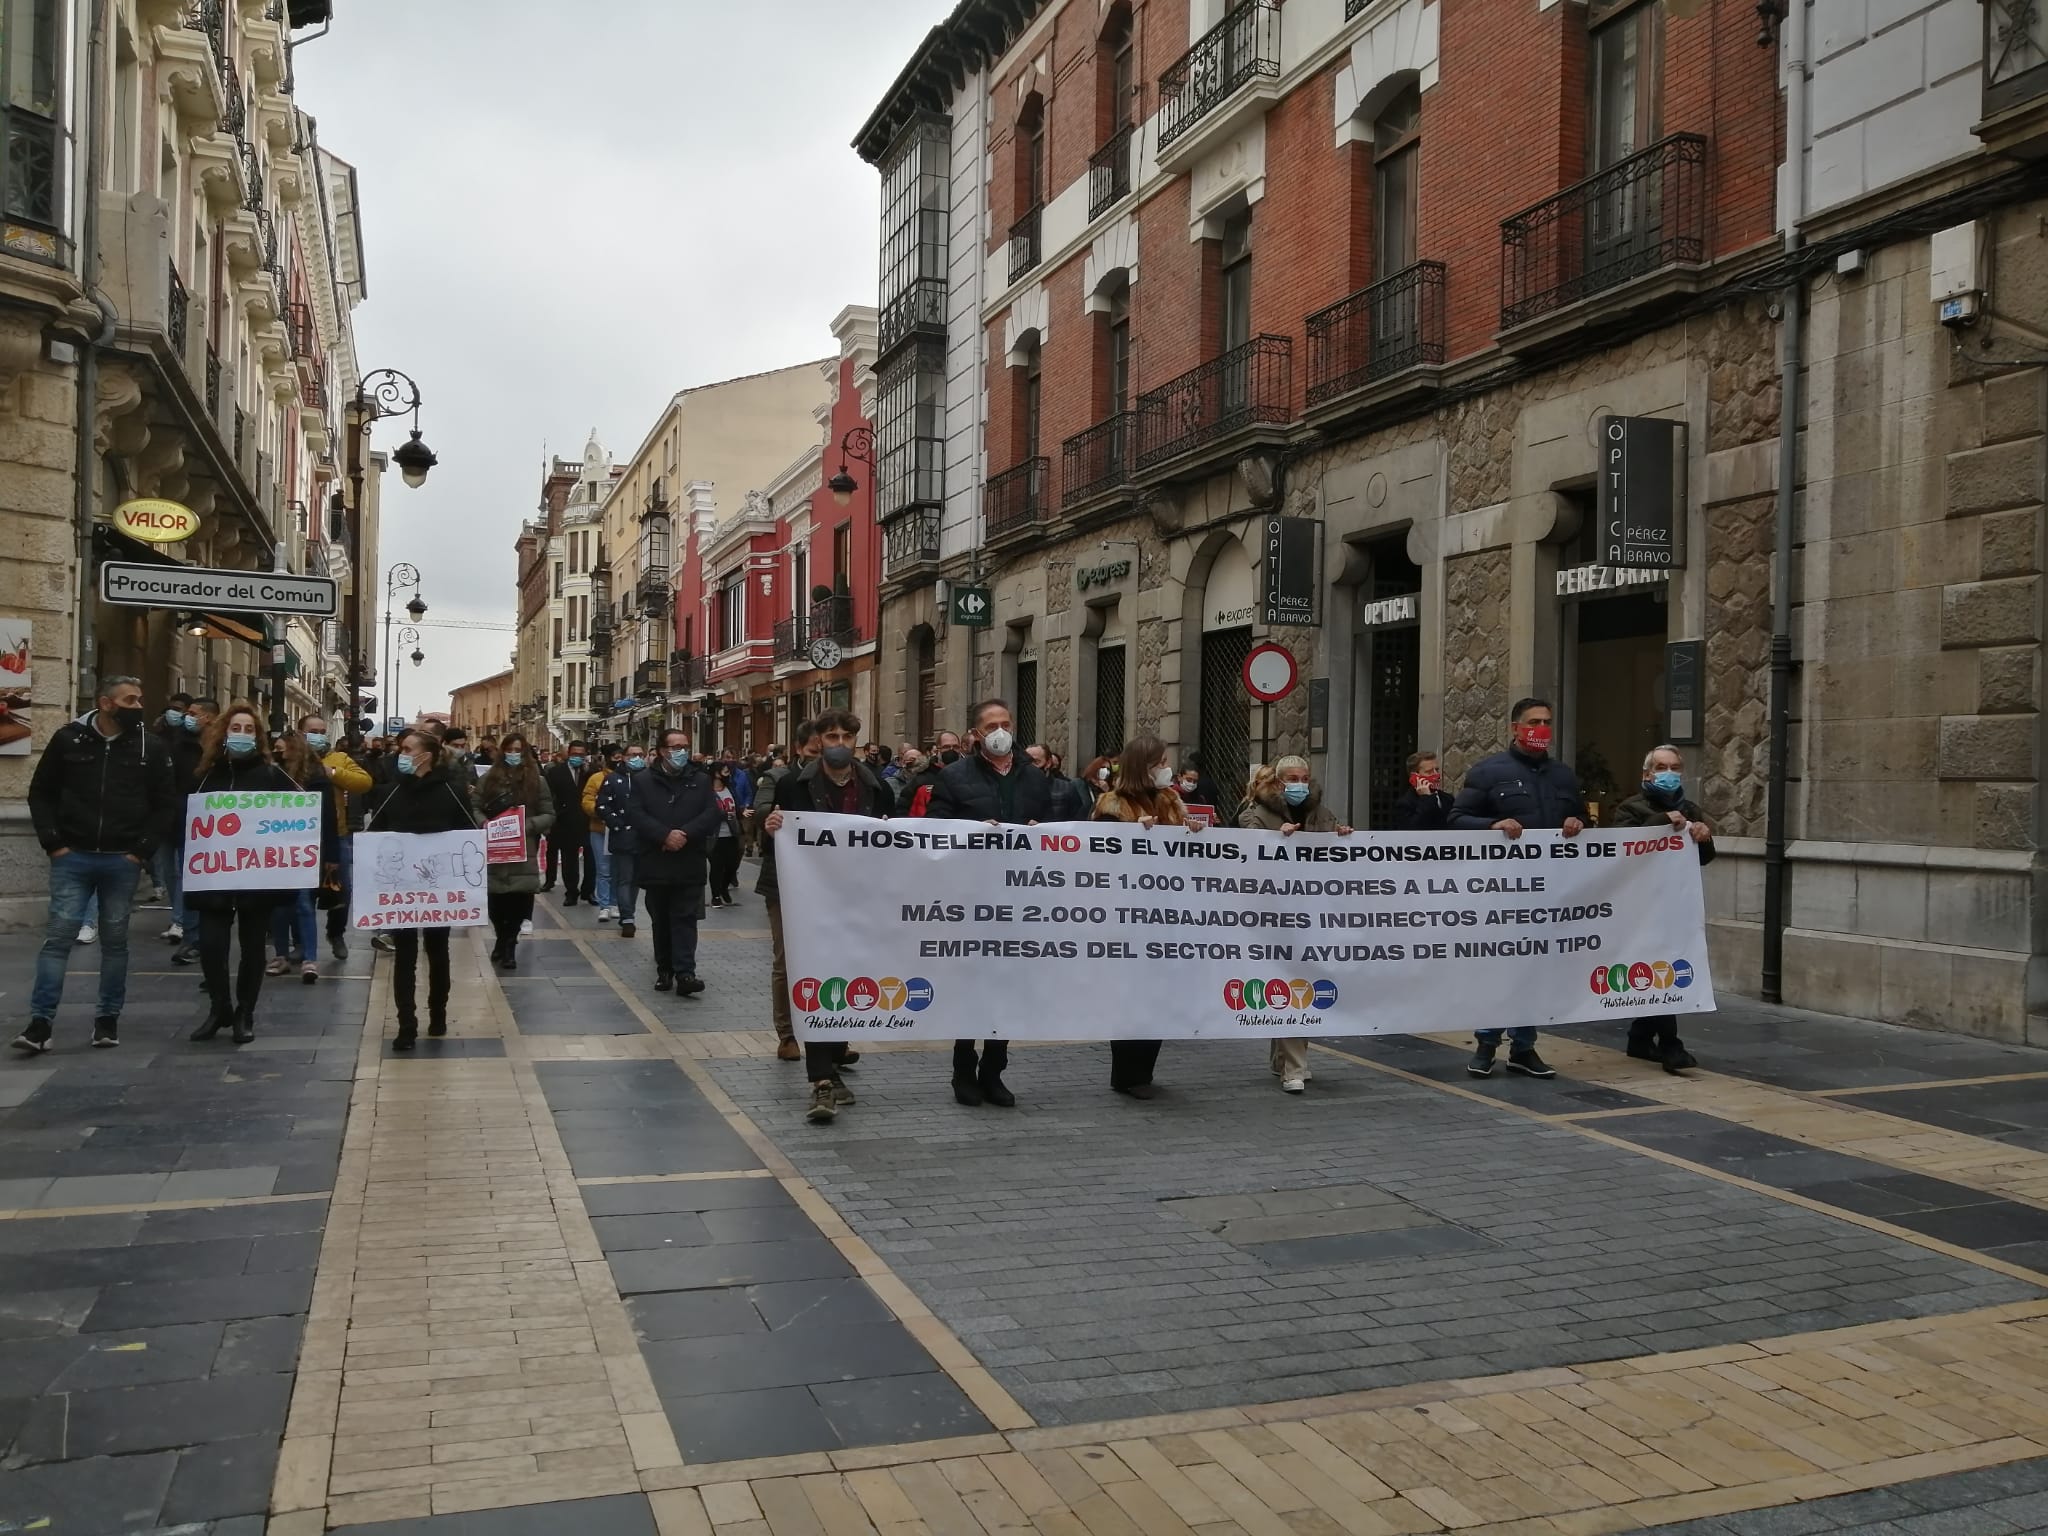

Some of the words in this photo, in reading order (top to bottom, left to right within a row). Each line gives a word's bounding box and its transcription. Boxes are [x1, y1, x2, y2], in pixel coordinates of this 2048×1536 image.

[1608, 420, 1624, 561] ÓPTICA
[123, 510, 188, 530] VALOR
[1627, 525, 1667, 541] PÉREZ
[1627, 550, 1671, 563] BRAVO
[1090, 560, 1131, 586] express
[1556, 564, 1615, 595] PEREZ
[117, 575, 221, 597] Procurador
[227, 584, 255, 599] del
[261, 585, 324, 603] Común
[1280, 595, 1309, 607] PÉREZ
[1280, 613, 1311, 623] BRAVO
[1365, 597, 1415, 625] OPTICA
[205, 793, 320, 810] NOSOTROS
[191, 813, 241, 840] NO
[256, 817, 318, 835] SOMOS
[797, 829, 836, 847] LA
[848, 829, 1032, 850] HOSTELERÍA
[1040, 835, 1081, 852] NO
[1089, 837, 1122, 854] ES
[1131, 838, 1158, 856] EL
[1163, 840, 1247, 863] VIRUS,
[1258, 845, 1289, 861] LA
[1295, 845, 1542, 862] RESPONSABILIDAD
[1550, 842, 1579, 859] ES
[1587, 842, 1617, 858] DE
[1622, 835, 1684, 857] TODOS
[189, 845, 319, 874] CULPABLES
[1005, 866, 1066, 887] MÁS
[1075, 872, 1110, 888] DE
[1118, 873, 1184, 891] 1.000
[1191, 876, 1396, 896] TRABAJADORES
[1403, 880, 1420, 894] A
[1428, 879, 1459, 894] LA
[1466, 877, 1545, 893] CALLE
[378, 892, 439, 905] BASTA
[447, 891, 466, 903] DE
[901, 901, 965, 922] MÁS
[974, 905, 1013, 922] DE
[1022, 906, 1106, 923] 2.000
[1115, 907, 1311, 929] TRABAJADORES
[1320, 910, 1477, 928] INDIRECTOS
[1485, 902, 1613, 925] AFECTADOS
[920, 940, 1078, 958] EMPRESAS
[1087, 942, 1137, 959] DEL
[1146, 942, 1241, 960] SECTOR
[1249, 944, 1293, 961] SIN
[1301, 944, 1404, 962] AYUDAS
[1413, 944, 1447, 960] DE
[1454, 937, 1548, 958] NINGÚN
[1556, 934, 1602, 954] TIPO
[1649, 994, 1659, 1004] de
[1662, 992, 1684, 1004] León
[804, 1015, 868, 1029] Hostelería
[869, 1015, 883, 1028] de
[885, 1014, 915, 1029] León
[1286, 1014, 1297, 1025] de
[1300, 1012, 1322, 1026] León
